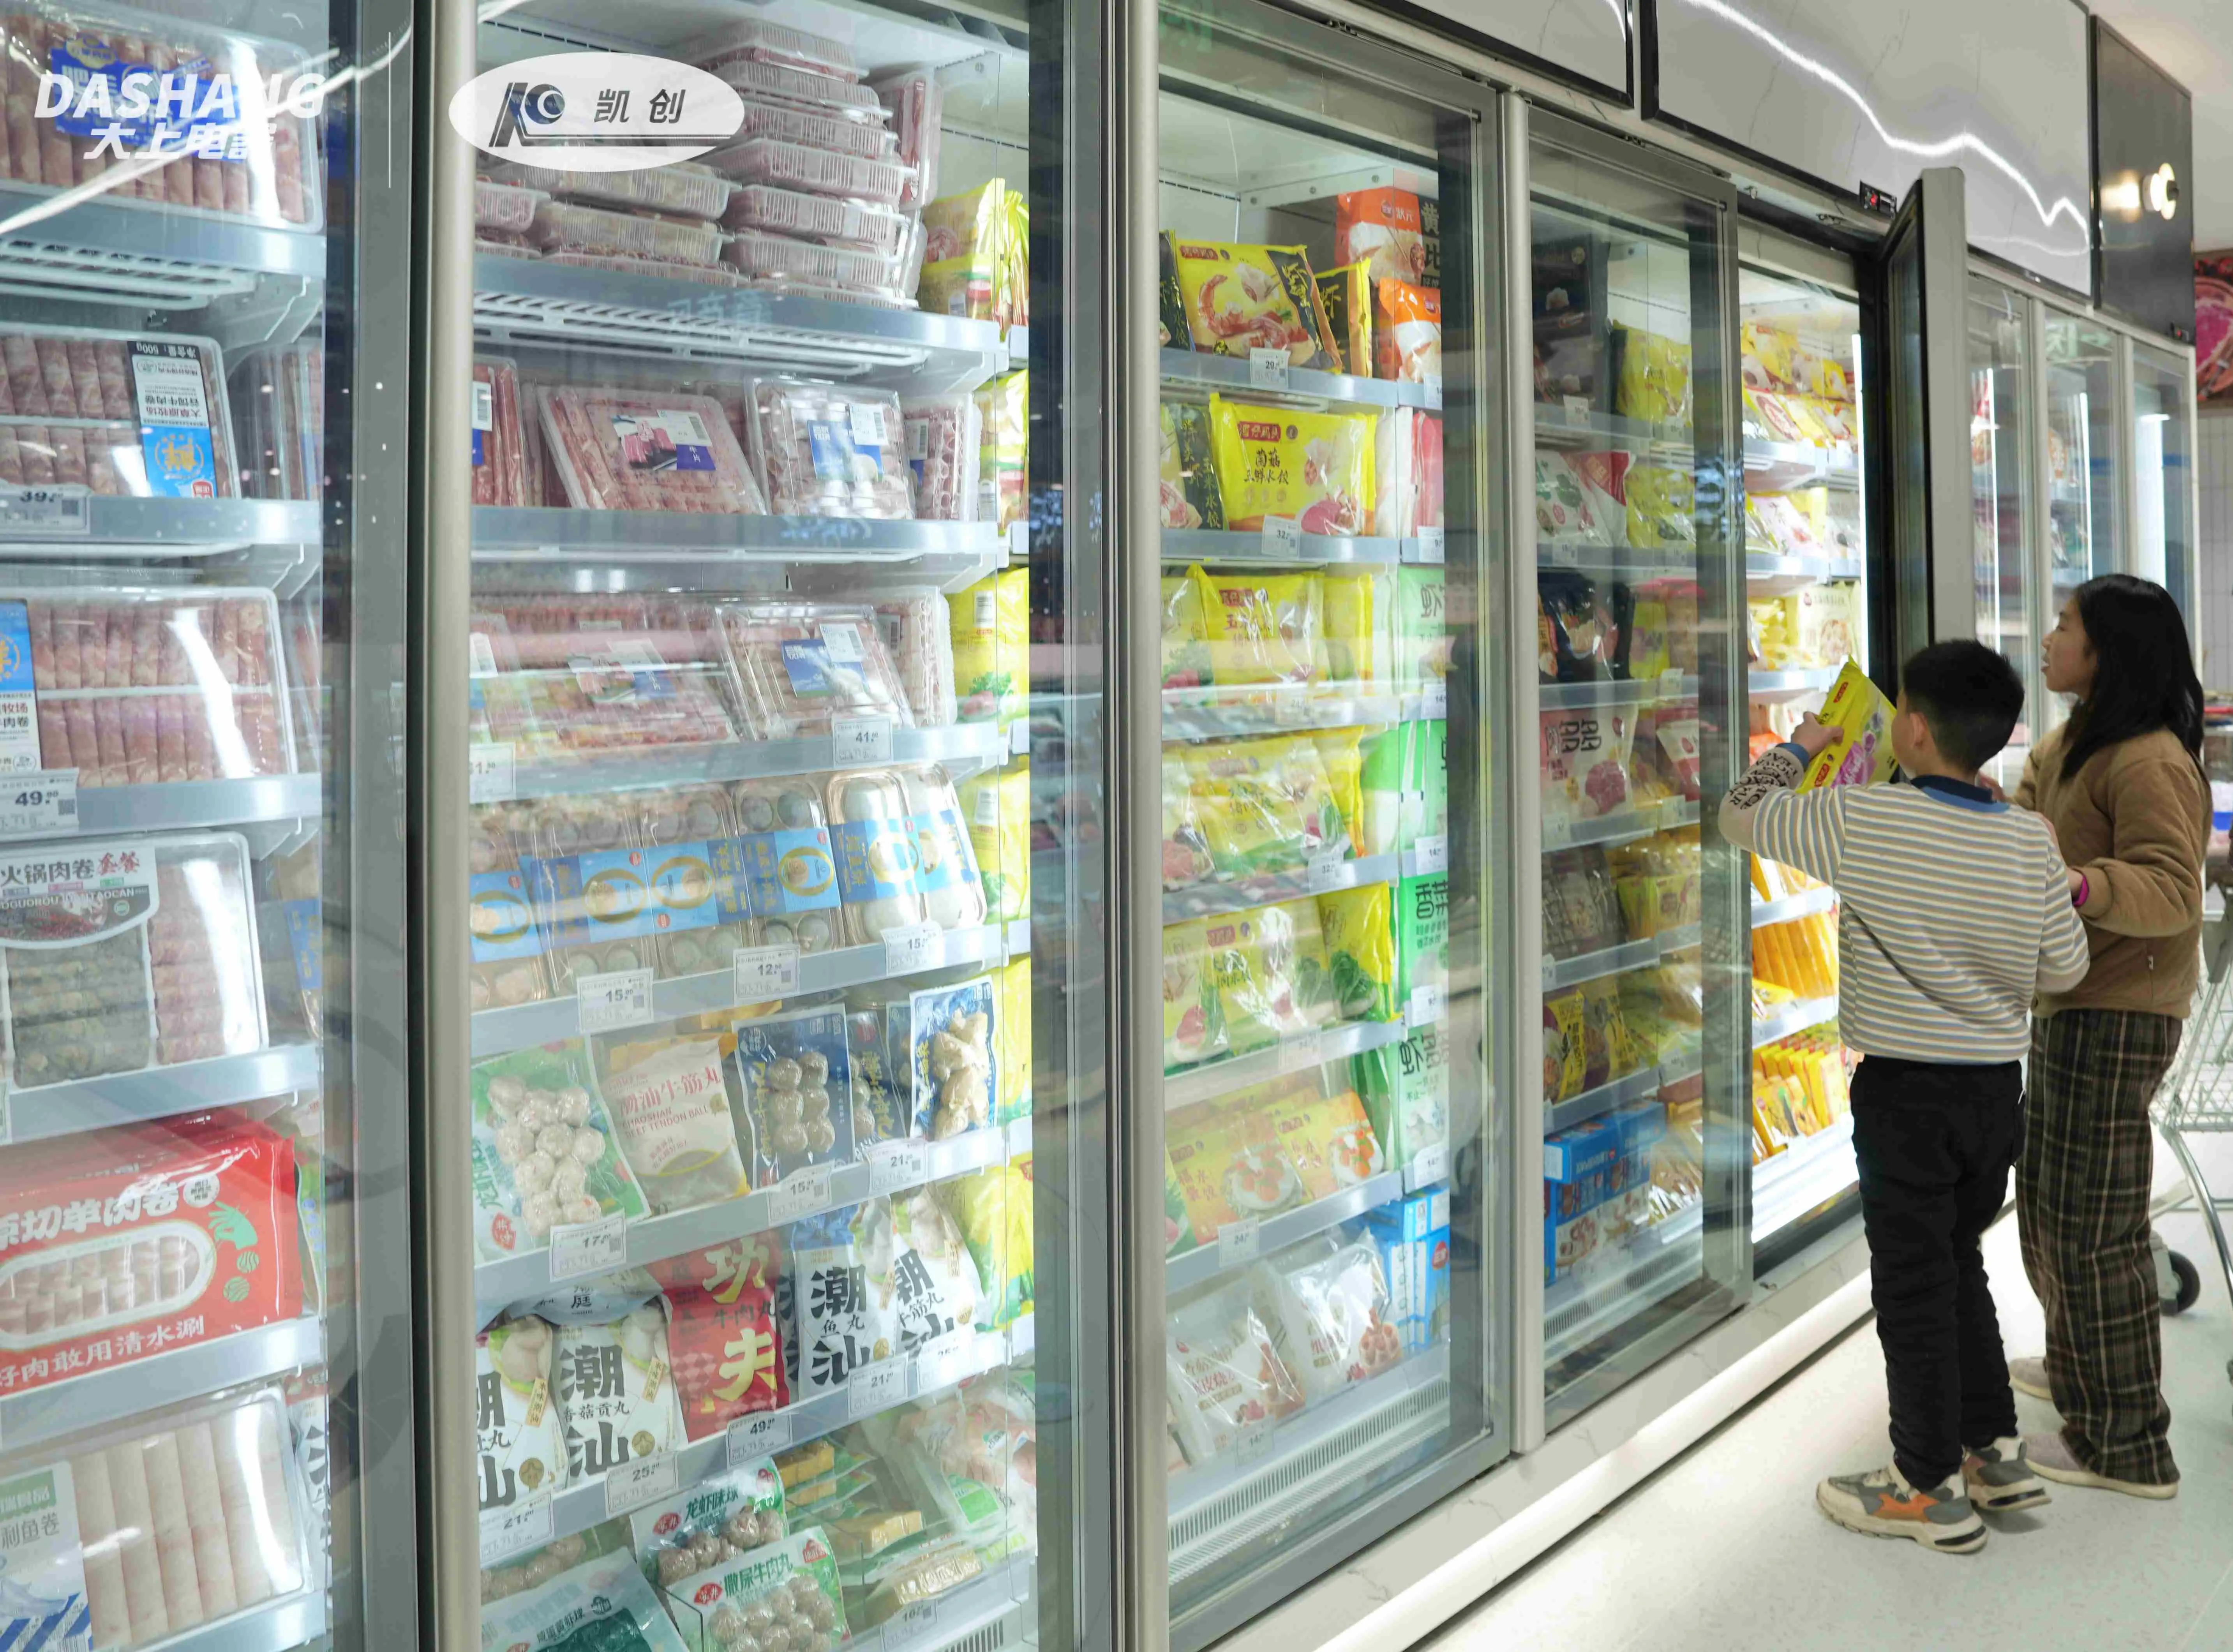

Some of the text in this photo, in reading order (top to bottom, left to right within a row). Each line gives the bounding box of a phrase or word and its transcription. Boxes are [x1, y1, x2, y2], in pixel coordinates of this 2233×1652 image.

[0, 702, 28, 714] 牧场
[0, 716, 29, 728] 肉卷
[713, 1299, 776, 1328] 牛肉丸
[564, 1401, 630, 1423] 香菇贡丸
